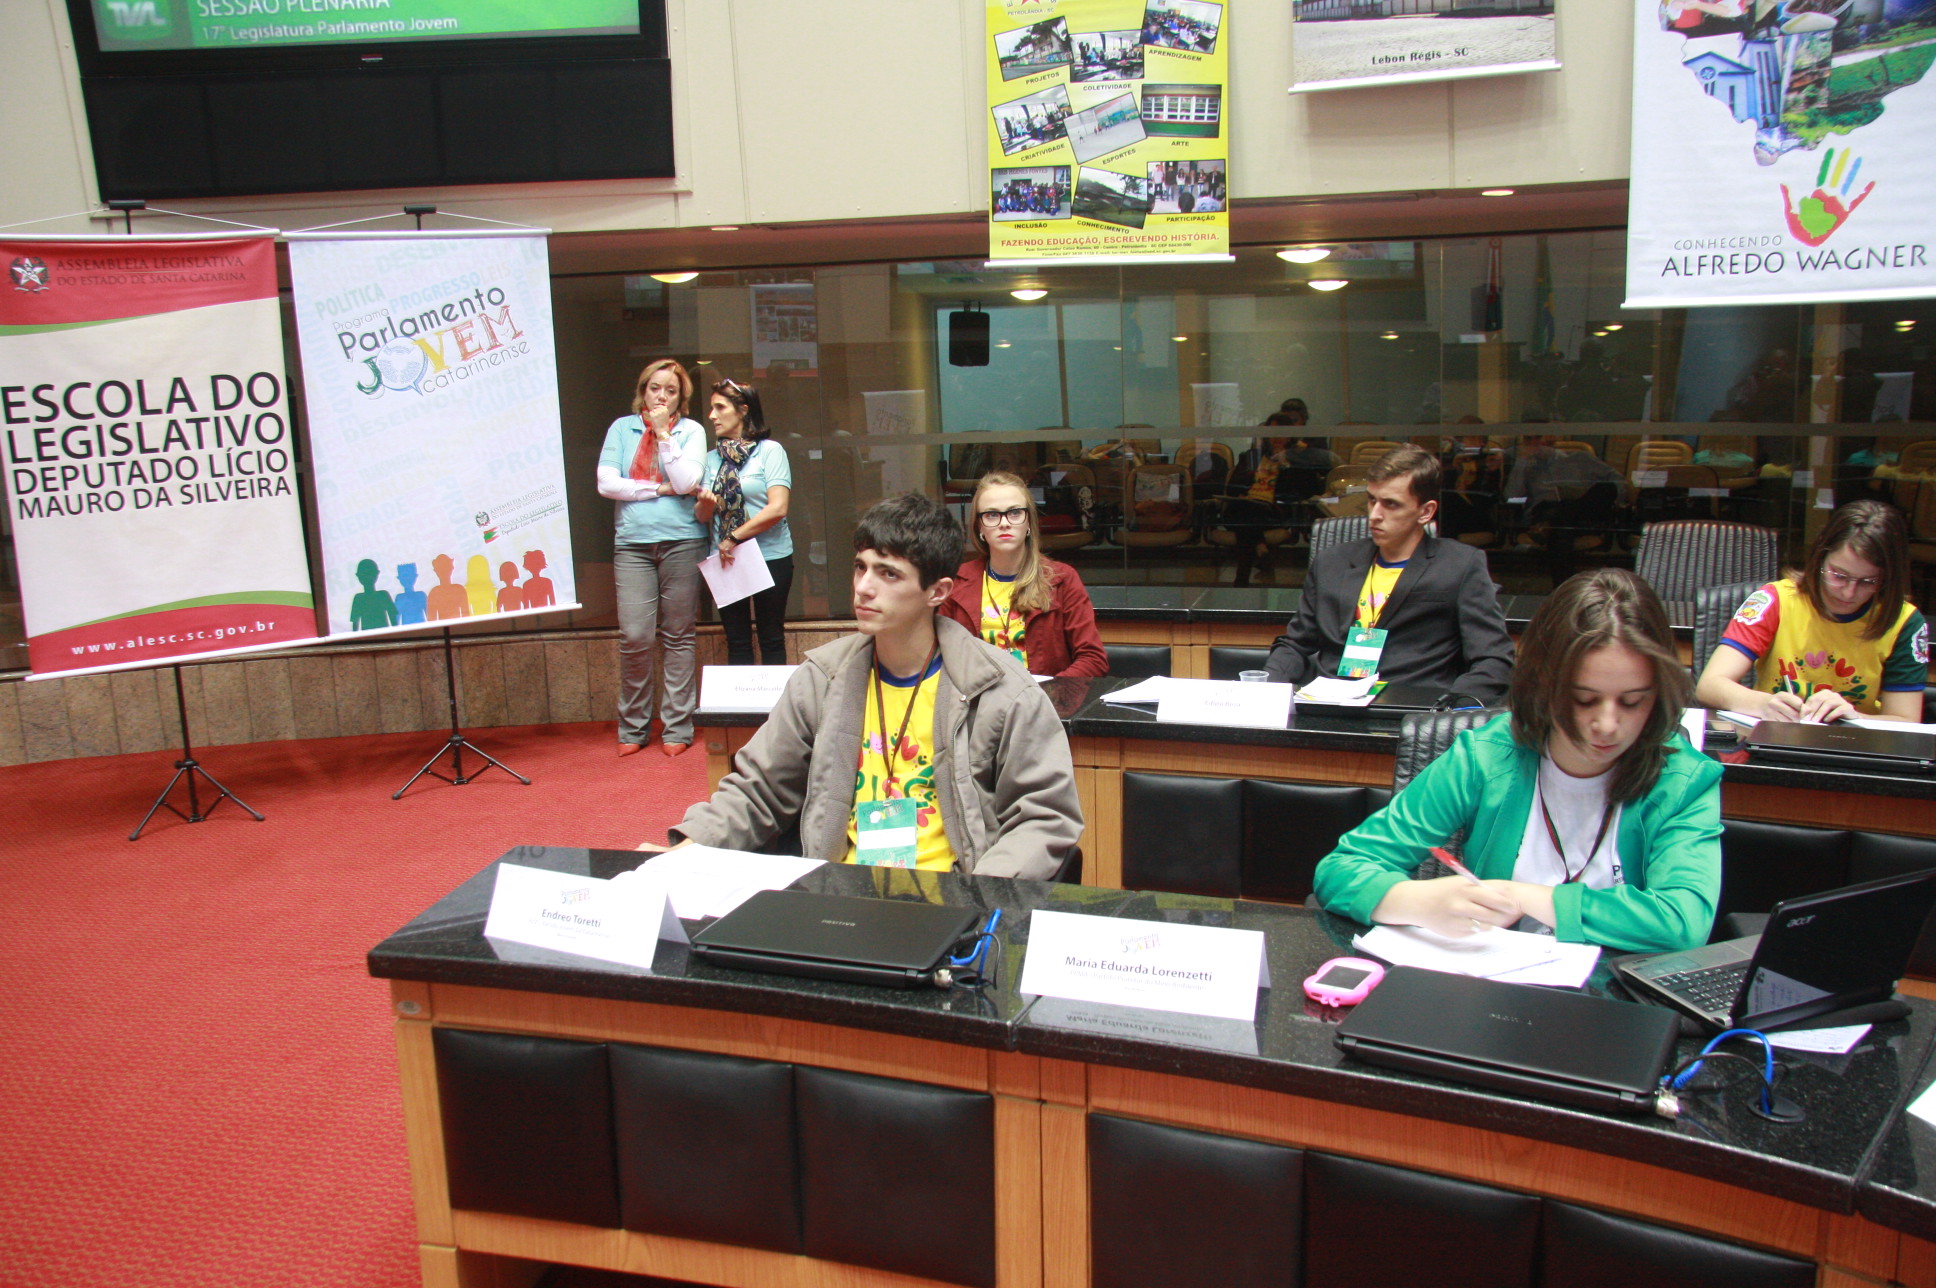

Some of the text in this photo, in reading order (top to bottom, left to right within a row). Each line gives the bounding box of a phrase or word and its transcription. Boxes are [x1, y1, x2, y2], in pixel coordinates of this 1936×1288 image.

[231, 23, 314, 42] Legislatura
[318, 19, 405, 35] Parlamento
[409, 17, 459, 31] Jovem
[1148, 49, 1202, 62] APRENDIZAGEM
[1371, 53, 1406, 66] Lebon
[1410, 50, 1442, 63] Régis
[1454, 47, 1470, 58] SC
[1026, 71, 1060, 85] PROJETOS
[1083, 83, 1132, 92] COLETIVIDADE
[1020, 143, 1065, 162] CRIATIVIDADE
[1102, 148, 1137, 165] ESPORTES
[1014, 222, 1048, 230] INCLUSÃO
[1076, 220, 1130, 235] CONHECIMENTO
[1166, 214, 1216, 223] PARTICIPAÇÃO
[1001, 231, 1220, 247] FAZENDO EDUCAÇÃO, ESCREVENDO HISTÓRIA.
[1674, 234, 1783, 251] CONHECENDO
[56, 255, 245, 271] ASSEMBLEIA LEGISLATIVA
[1661, 244, 1928, 278] ALFREDO WAGNER
[57, 271, 247, 287] DO ESTADO DE SANTA CATARINA
[315, 282, 386, 321] POLÍTICA
[332, 308, 391, 333] Programa
[337, 287, 506, 360] Parlamento
[422, 340, 531, 394] catarinense
[1, 371, 282, 425] ESCOLA DO
[7, 412, 285, 464] LEGISLATIVO
[13, 447, 289, 495] DEPUTADO LÍCIO
[19, 475, 292, 520] MAURO DA SILVEIRA
[71, 620, 277, 655] www.alesc.sc.gov.br
[541, 908, 572, 922] Endreo
[574, 914, 602, 928] Toretti
[1787, 914, 1817, 928] acer
[1065, 956, 1213, 982] Maria Eduarda Lorenzetti
